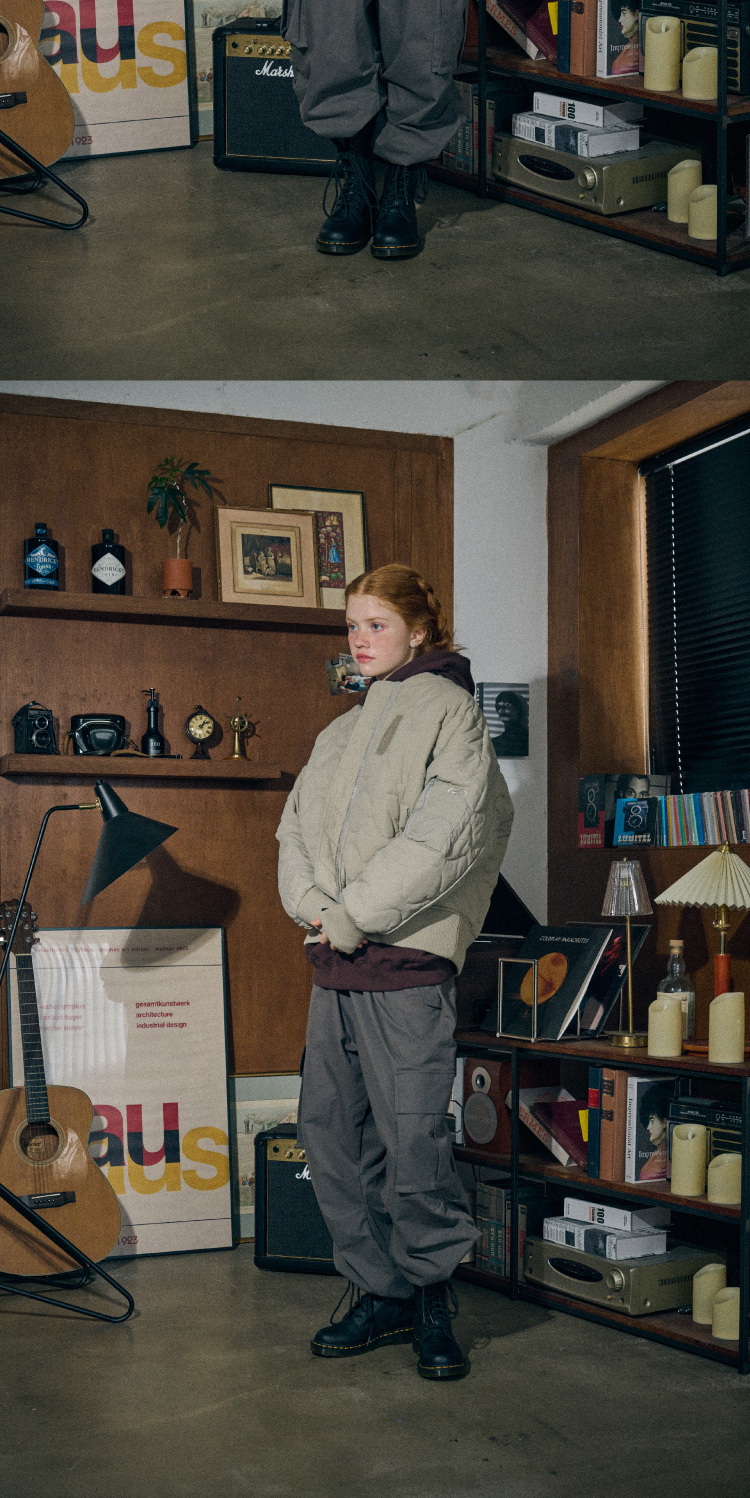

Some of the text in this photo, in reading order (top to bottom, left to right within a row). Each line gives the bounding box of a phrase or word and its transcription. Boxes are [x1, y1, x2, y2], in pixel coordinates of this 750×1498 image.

[567, 102, 576, 119] 100
[136, 1000, 190, 1008] gesamtkunstwerk
[597, 1207, 605, 1224] 100
